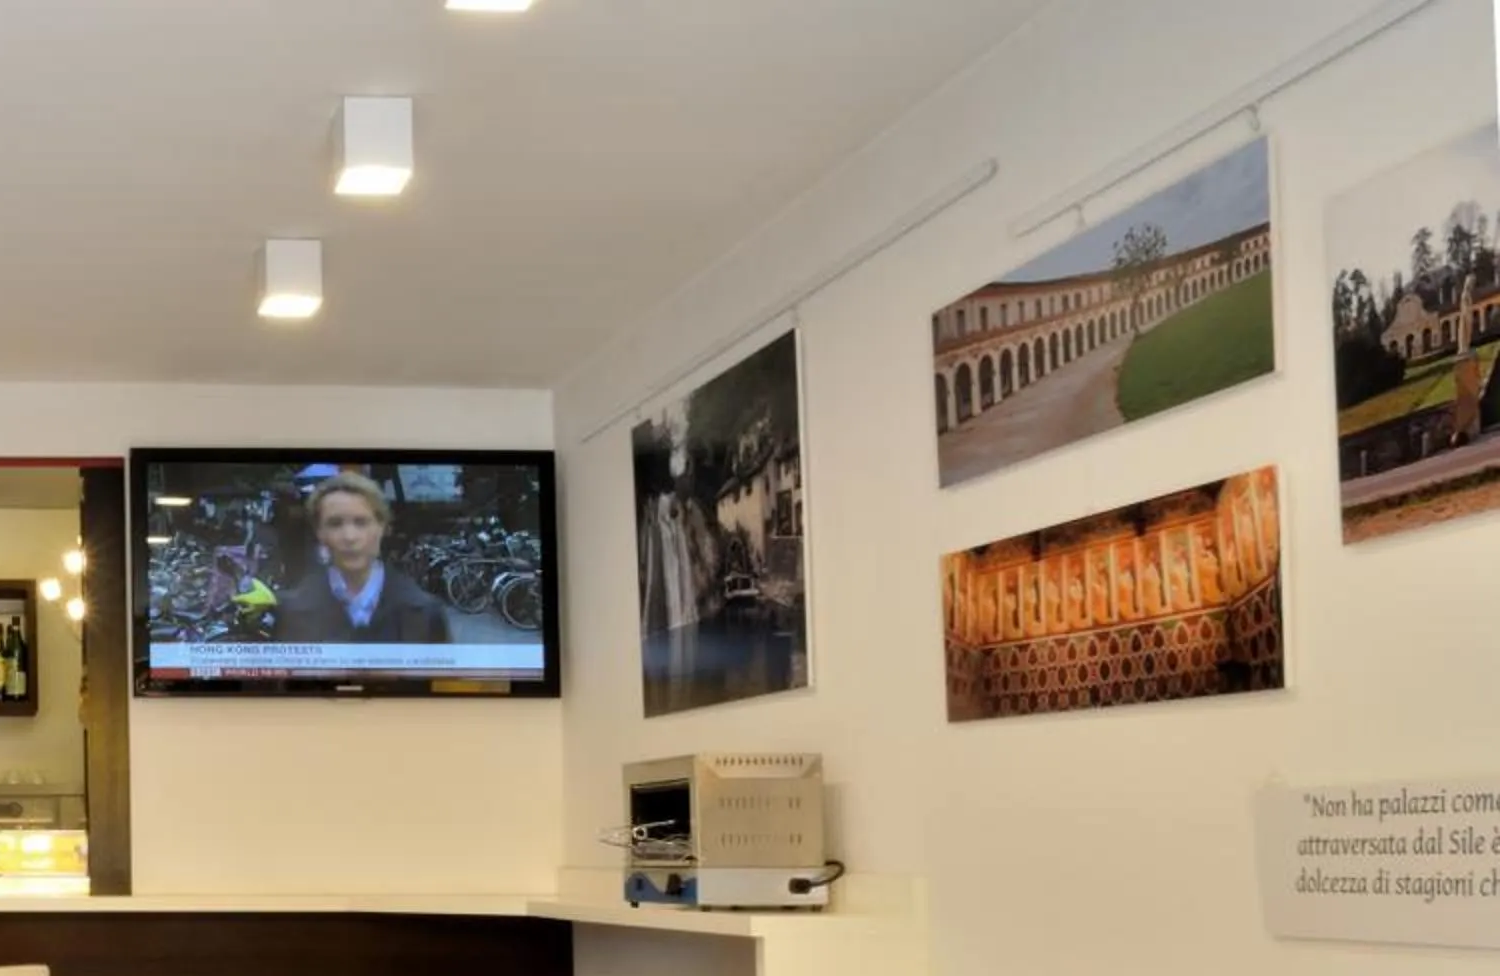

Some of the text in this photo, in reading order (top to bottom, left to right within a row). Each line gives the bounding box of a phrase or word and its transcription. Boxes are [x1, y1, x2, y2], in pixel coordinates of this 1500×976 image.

[1351, 789, 1374, 817] ha
[1379, 788, 1446, 823] palazzi
[1297, 835, 1407, 856] attraversata
[1412, 826, 1443, 856] dal
[1448, 826, 1486, 855] Sile
[1295, 866, 1367, 894] dolcezza
[1371, 867, 1391, 895] di
[1395, 870, 1474, 904] stagioni
